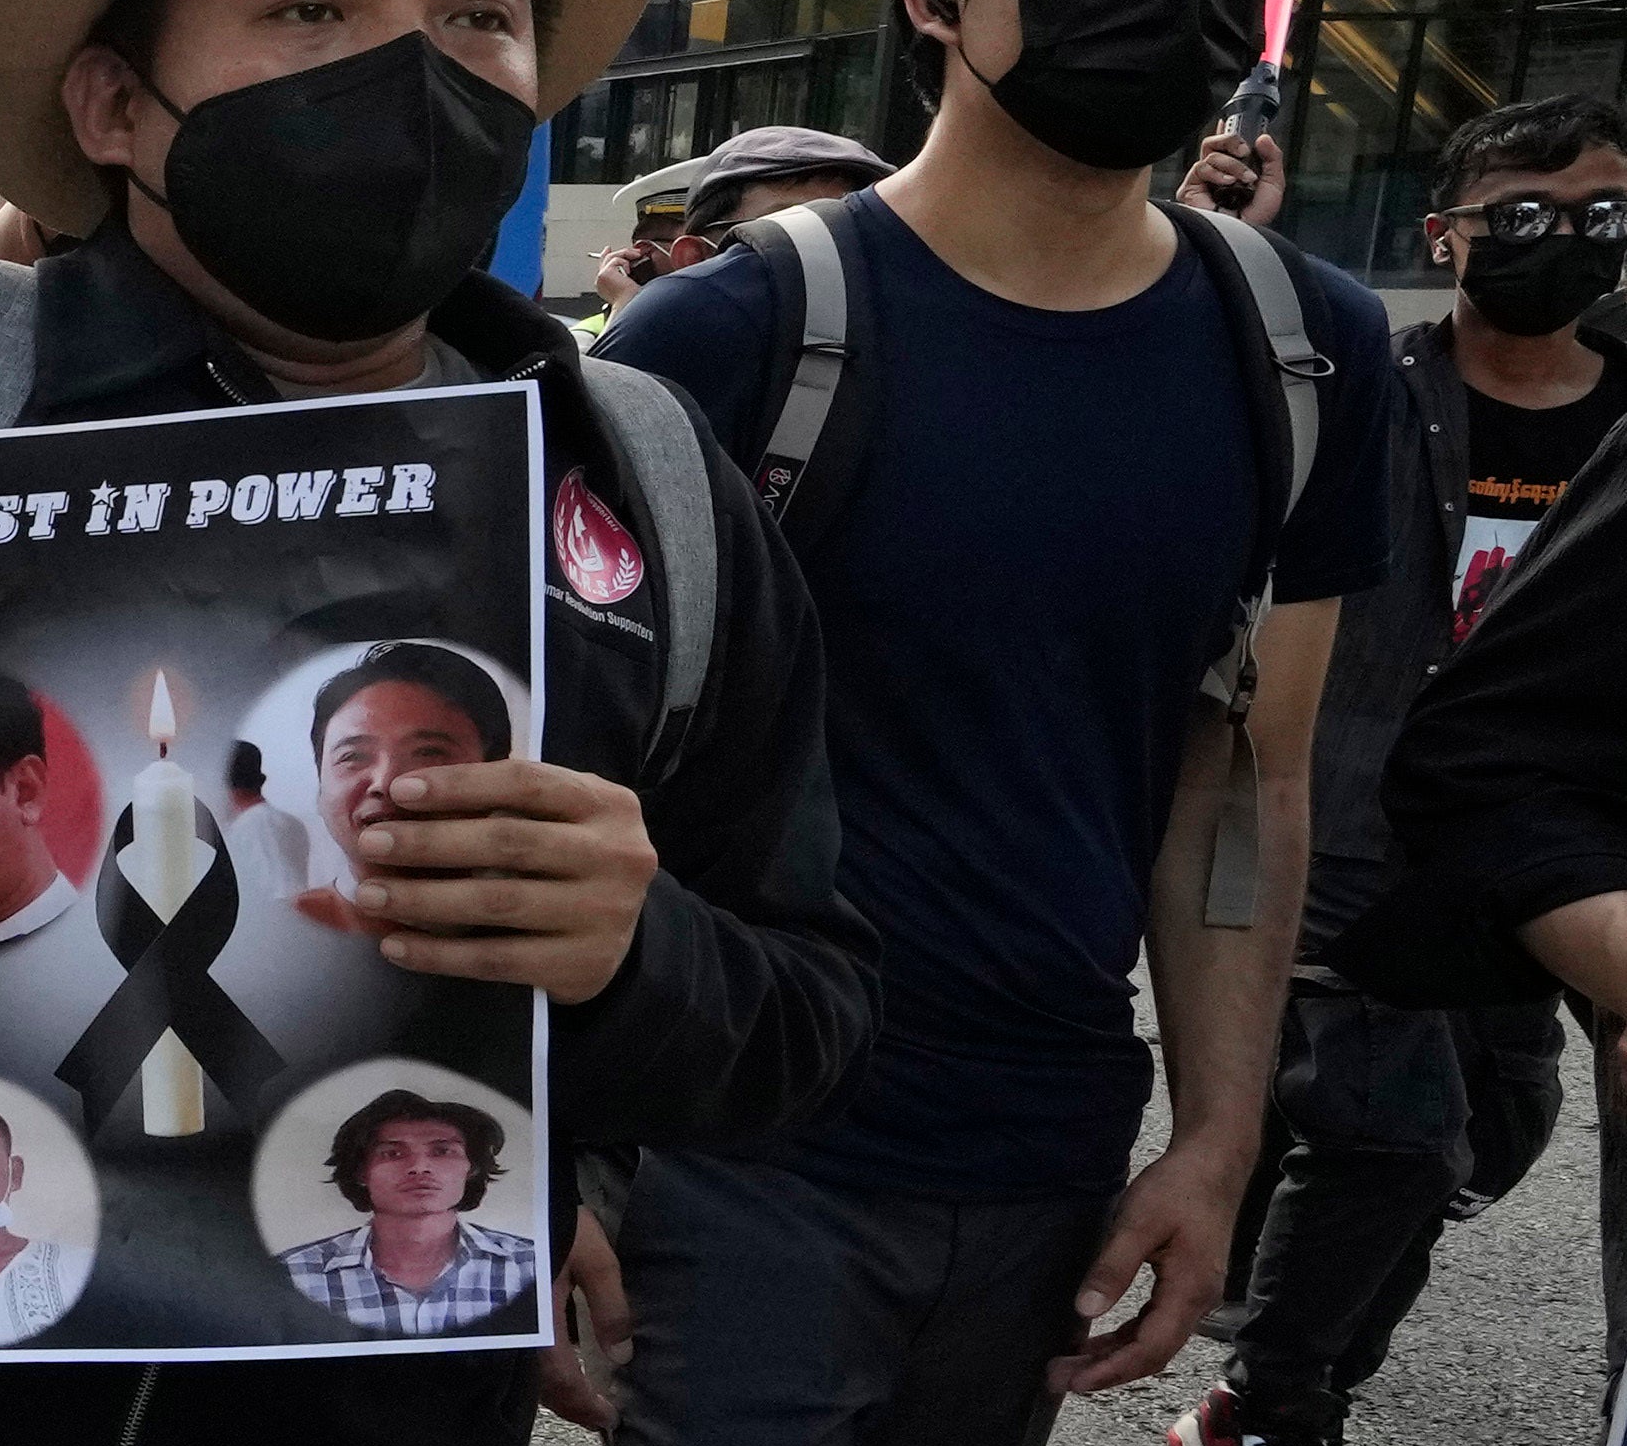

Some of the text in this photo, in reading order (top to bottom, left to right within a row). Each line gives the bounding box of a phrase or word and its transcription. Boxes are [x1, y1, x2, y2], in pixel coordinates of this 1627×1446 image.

[185, 463, 437, 528] POWER
[546, 583, 565, 602] mar
[606, 611, 655, 643] Supporters
